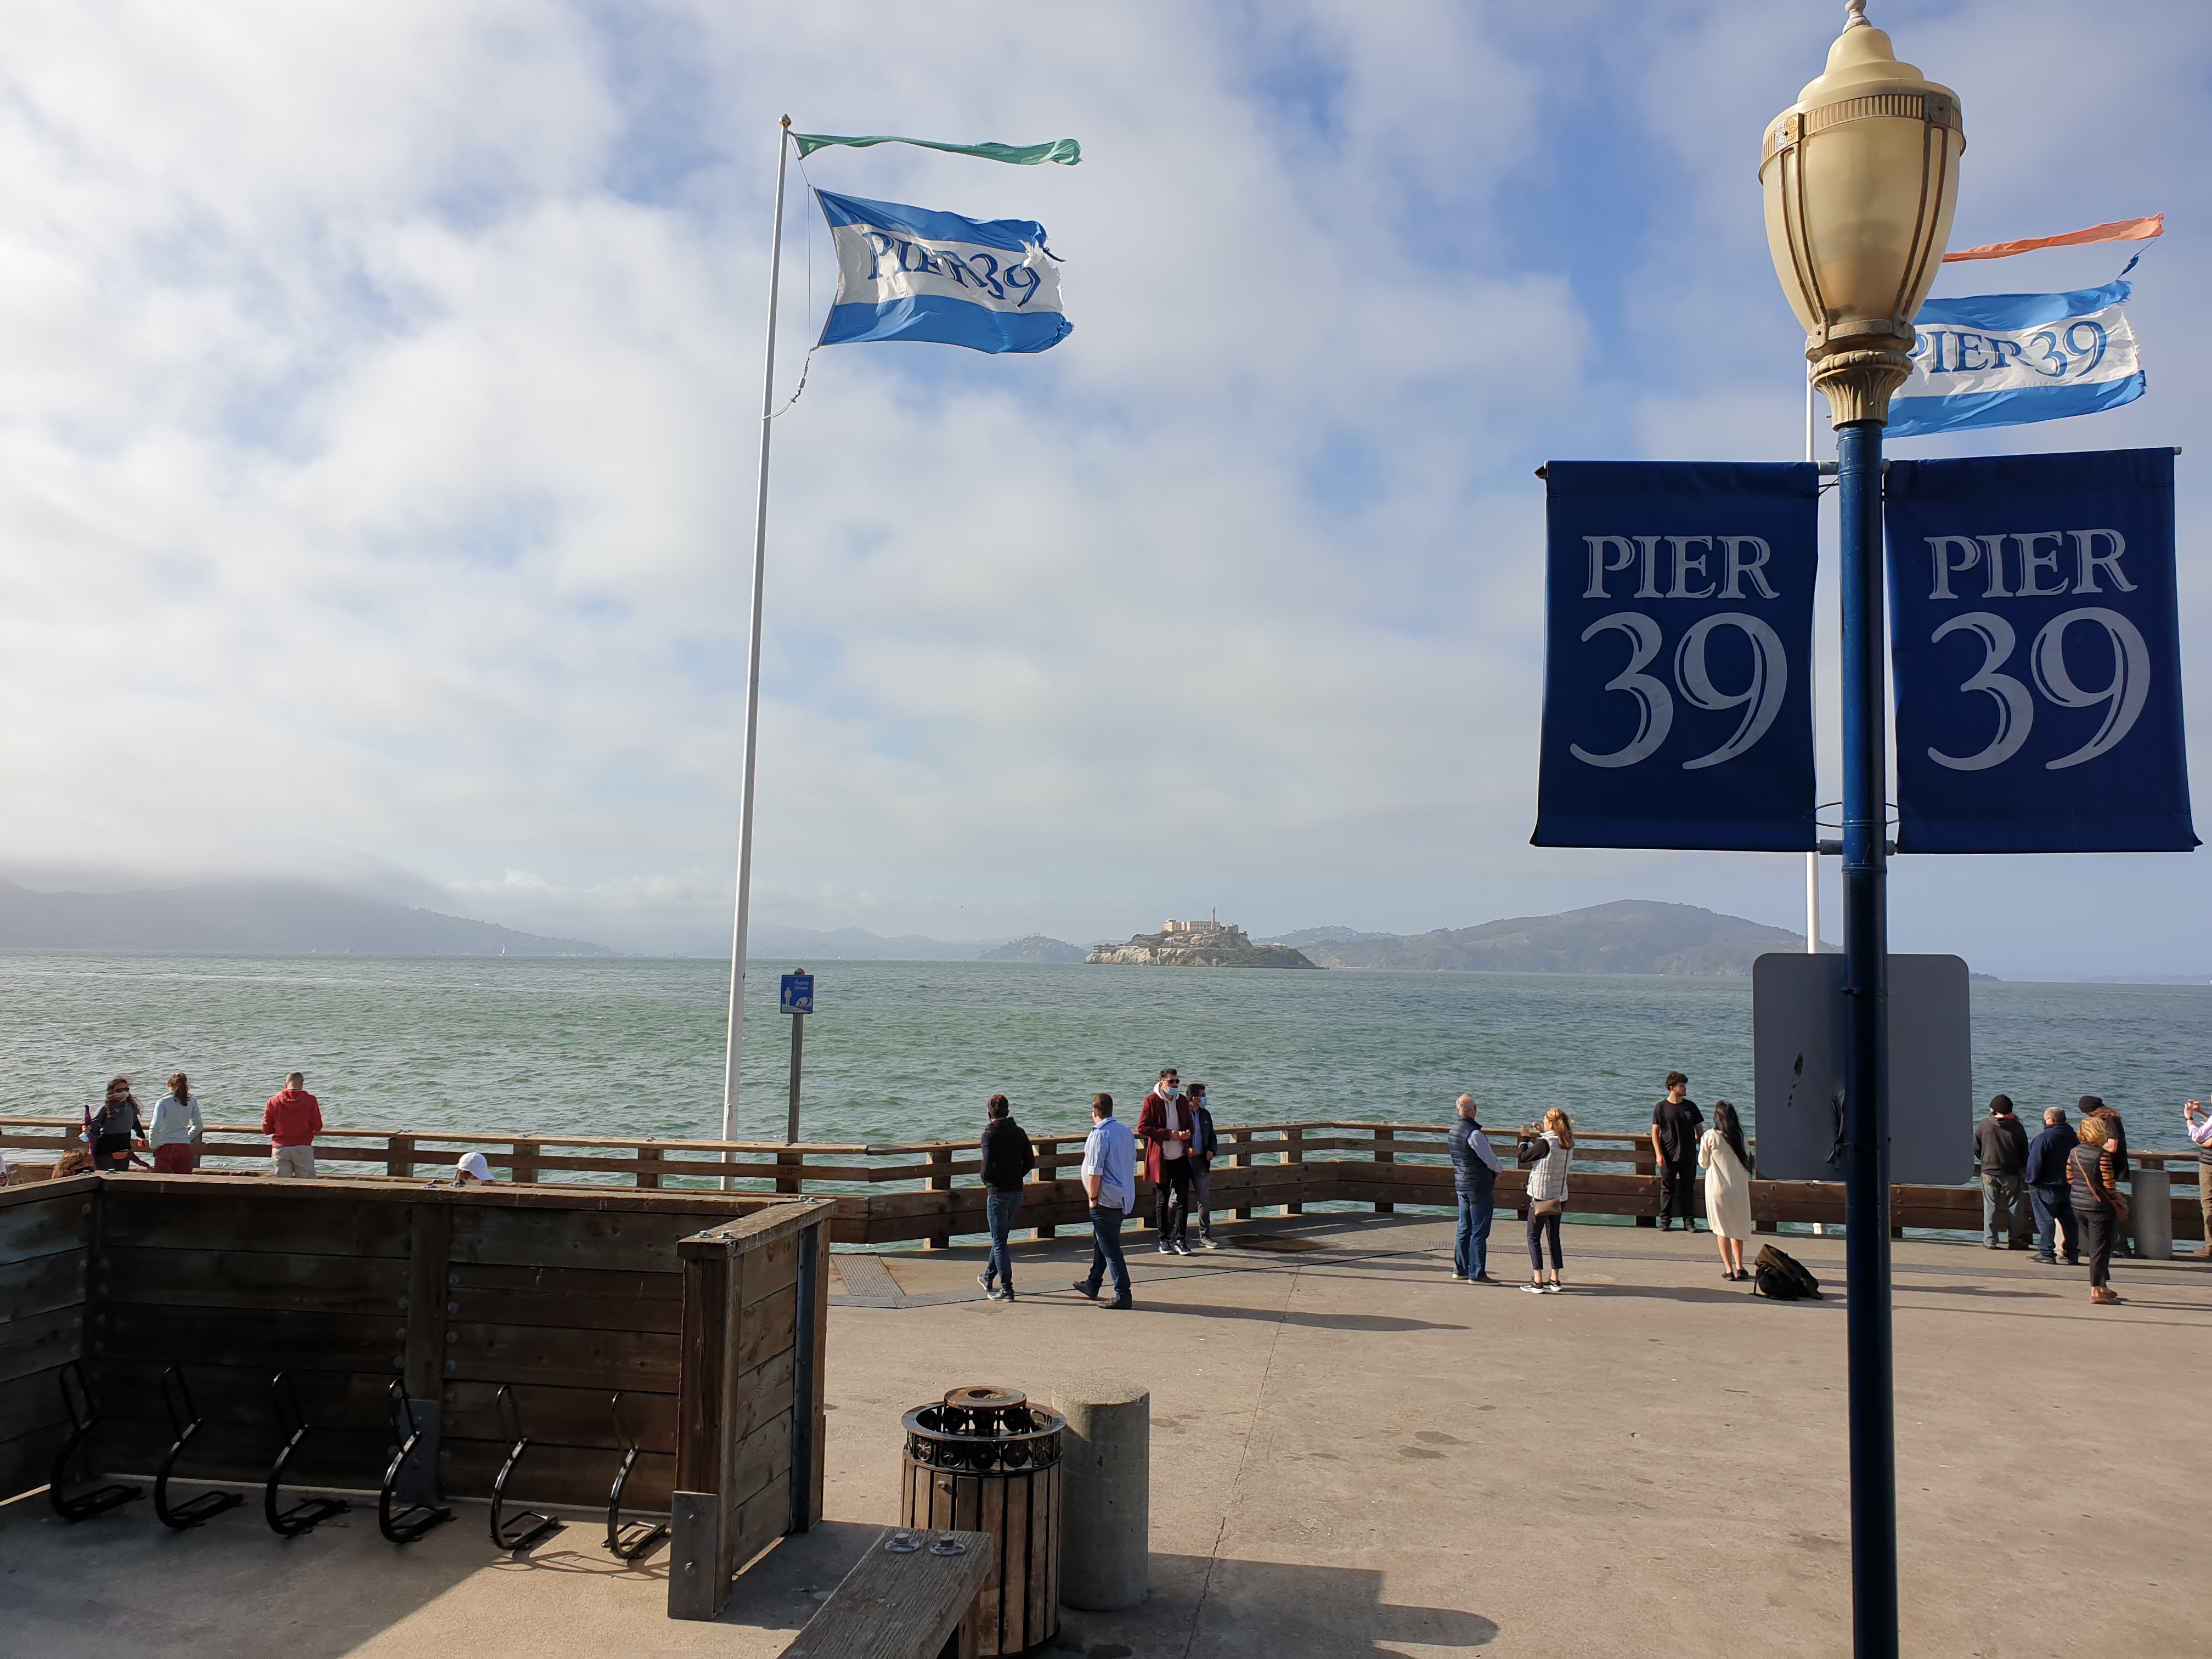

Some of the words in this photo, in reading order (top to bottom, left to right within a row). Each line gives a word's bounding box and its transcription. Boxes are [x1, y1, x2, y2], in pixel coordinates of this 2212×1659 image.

[861, 232, 988, 289] PIER
[969, 253, 1041, 308] 39
[2030, 320, 2107, 378] 39
[1582, 535, 1780, 600] PIER
[1924, 529, 2138, 600] PIER
[1570, 612, 1787, 770] 39
[1927, 607, 2151, 771] 39
